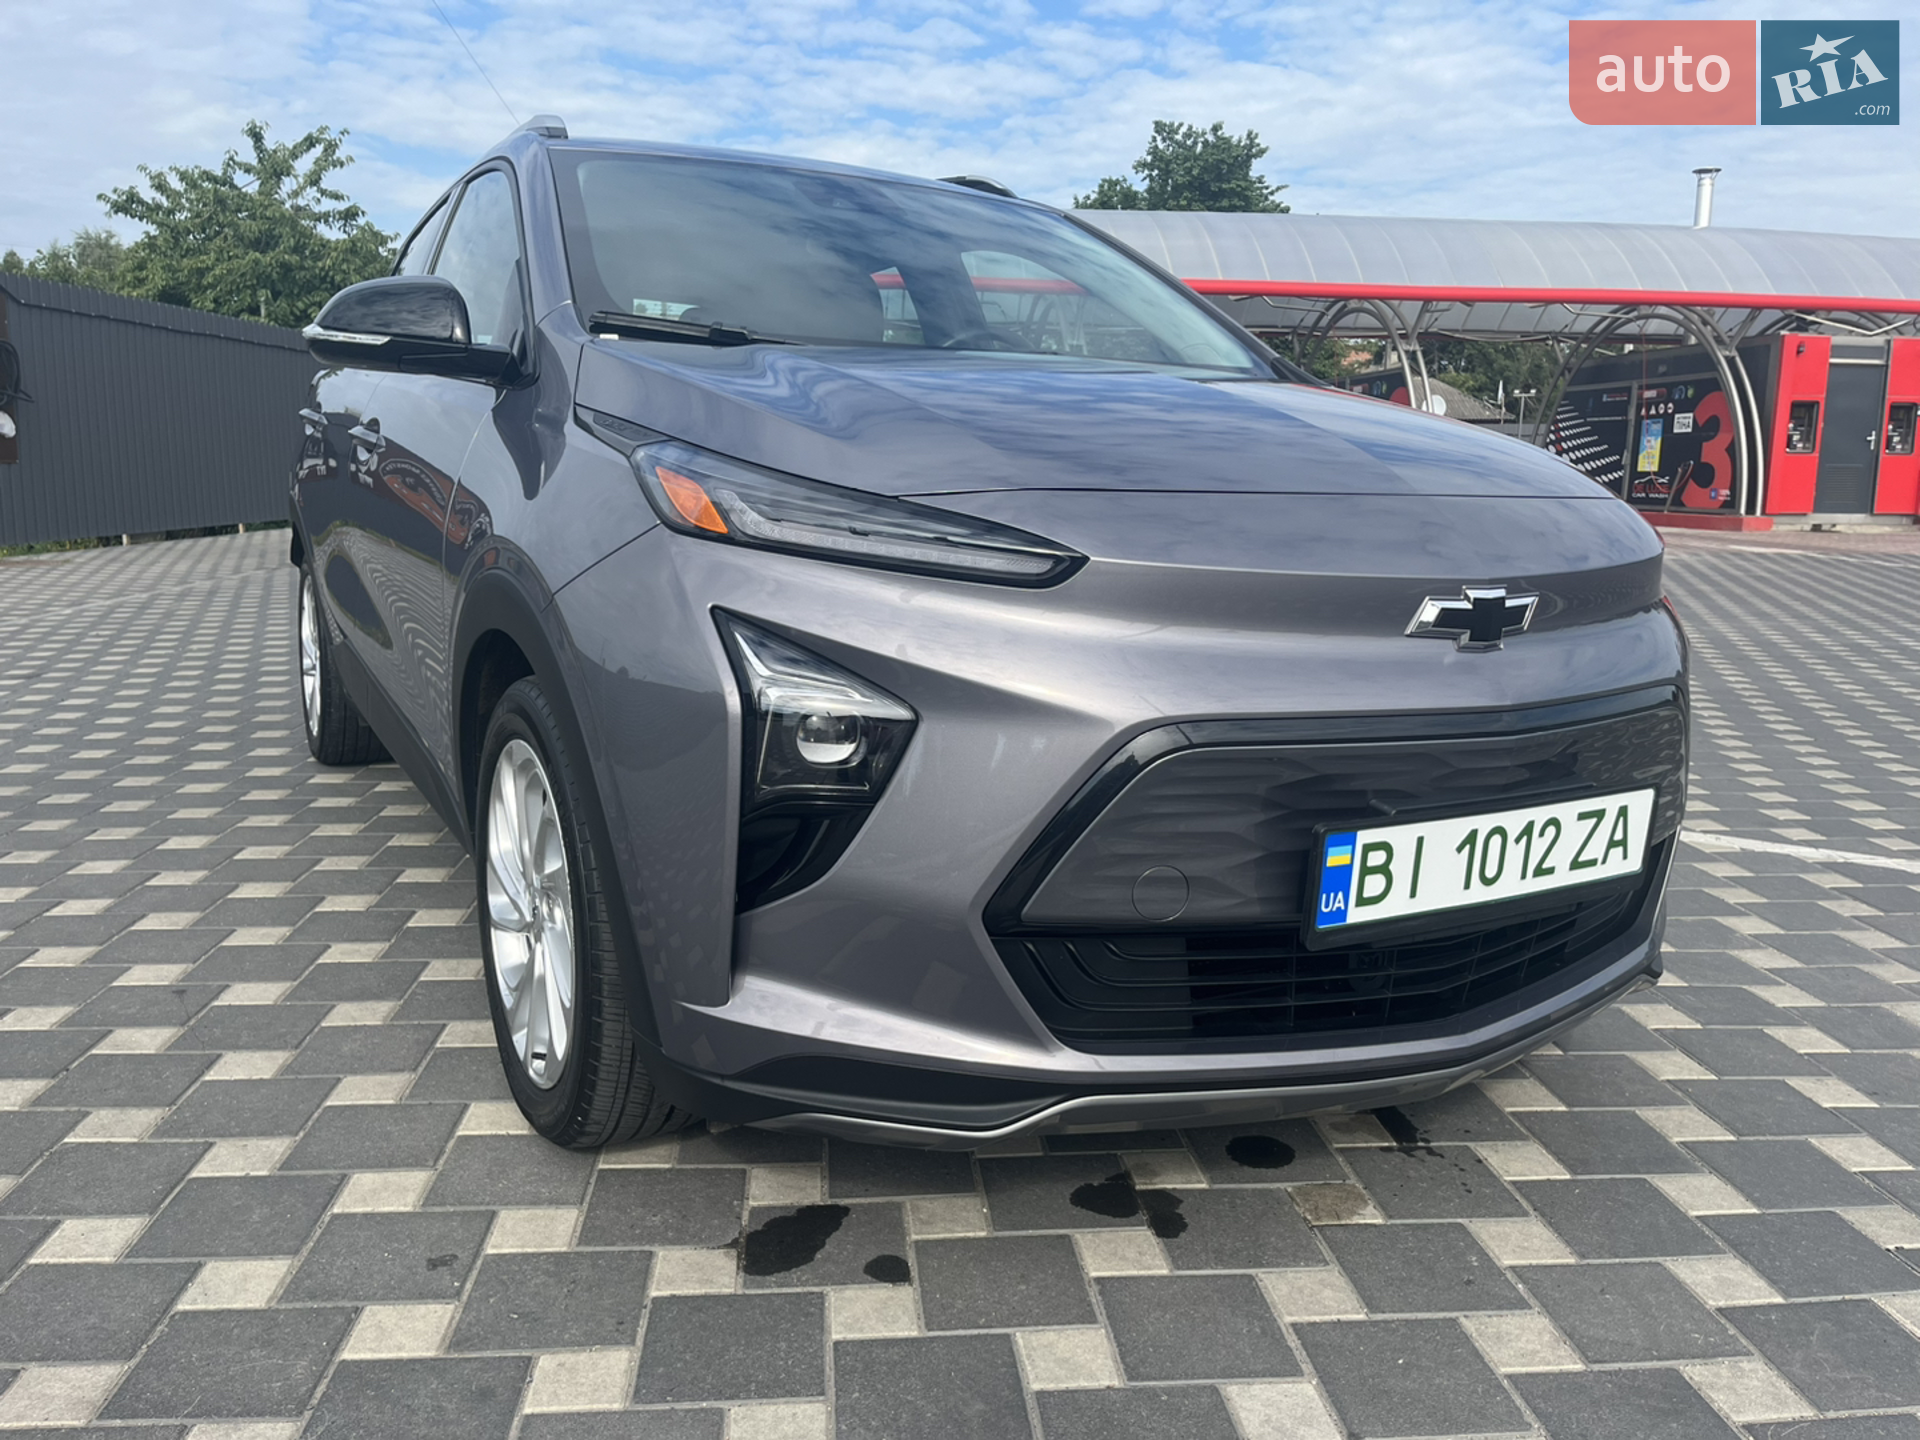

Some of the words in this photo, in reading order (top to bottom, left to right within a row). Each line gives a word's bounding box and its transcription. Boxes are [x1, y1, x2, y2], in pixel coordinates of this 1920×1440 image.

[1354, 836, 1425, 907] BI
[1455, 817, 1562, 890] 1012
[1568, 804, 1629, 871] ZA
[1320, 891, 1345, 912] UA
